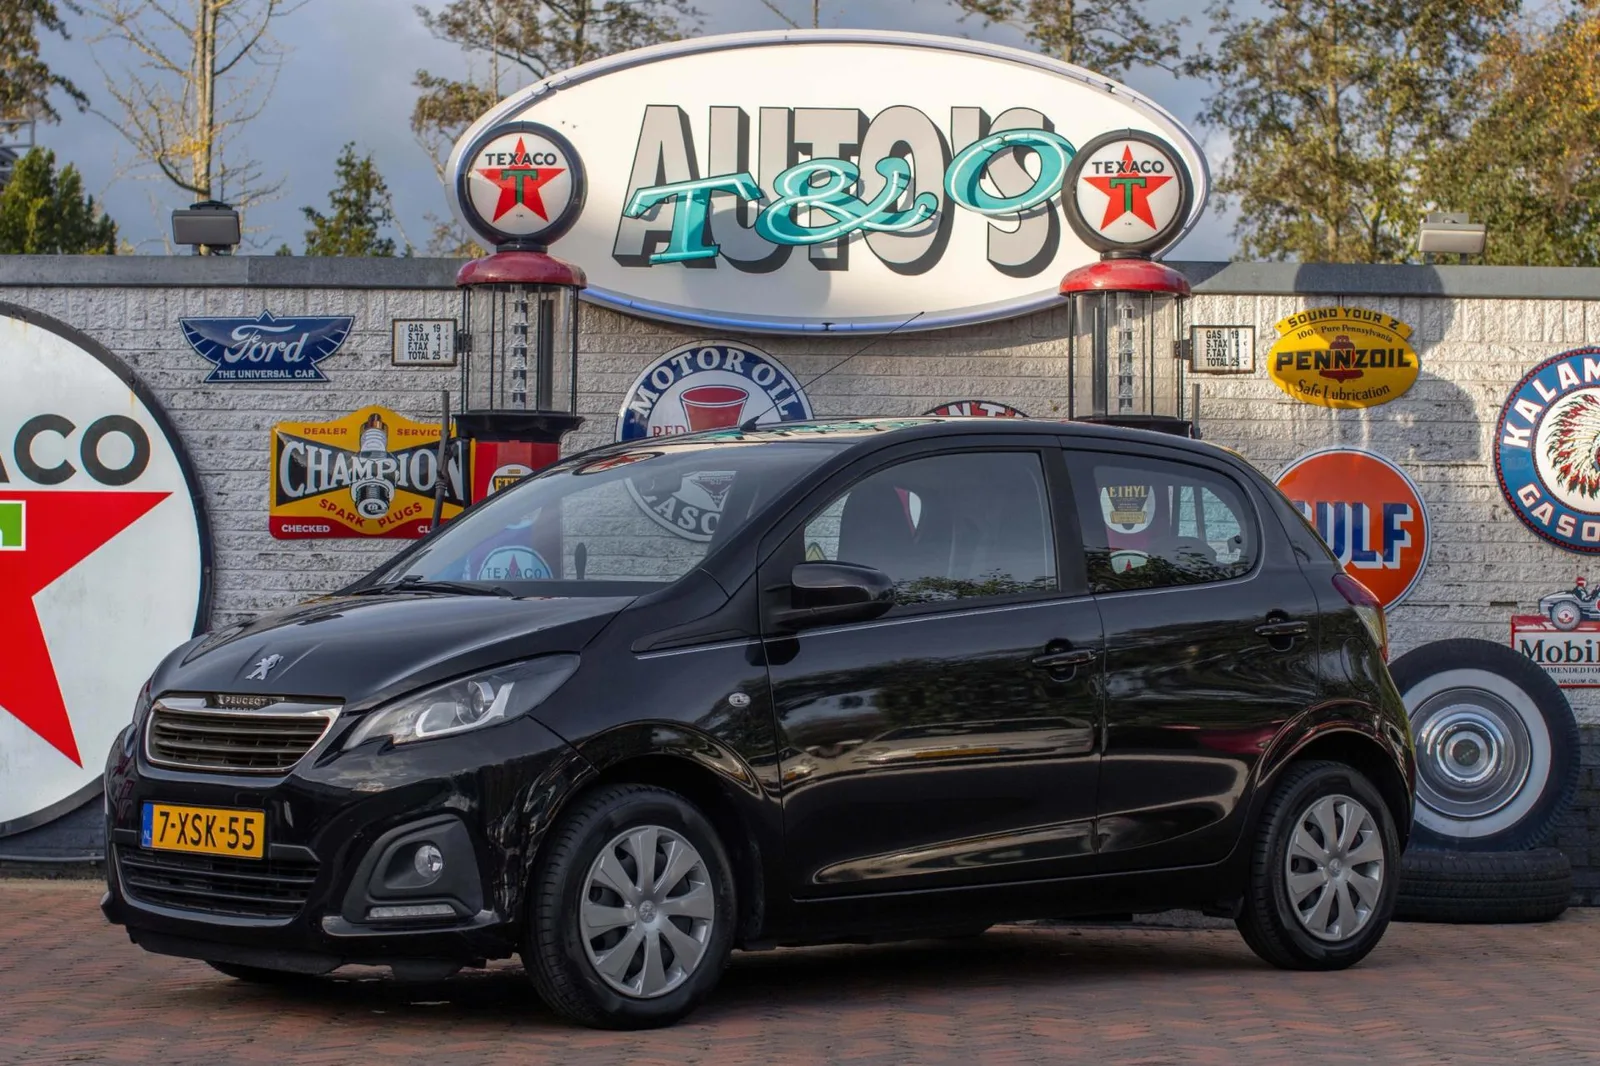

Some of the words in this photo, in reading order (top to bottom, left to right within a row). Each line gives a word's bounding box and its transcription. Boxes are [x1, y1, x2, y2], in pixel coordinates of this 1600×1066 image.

[485, 152, 557, 166] TEXACO
[1092, 160, 1164, 174] TEXACO
[1288, 308, 1338, 328] SOUND
[1343, 308, 1382, 324] YOUR
[1389, 319, 1400, 330] Z
[408, 323, 424, 333] GAS
[432, 323, 441, 333] 19
[1321, 325, 1341, 333] Pure
[1341, 324, 1393, 344] Pennsylvania
[408, 332, 430, 342] S.TAX
[1206, 330, 1222, 339] GAS
[1231, 330, 1239, 339] 19
[223, 324, 309, 364] Ford
[408, 342, 428, 351] F.TAX
[1206, 340, 1228, 349] S.TAX
[408, 351, 430, 360] TOTAL
[432, 351, 441, 360] 25
[1206, 349, 1227, 358] F.TAX
[1206, 358, 1229, 367] TOTAL
[1276, 348, 1412, 372] PENNZOIL
[217, 369, 236, 379] THE
[237, 369, 292, 379] UNIVERSAL
[295, 369, 316, 378] CAR
[629, 347, 746, 419] MOTOR
[751, 363, 799, 416] OIL
[1296, 379, 1322, 397] Safe
[1324, 384, 1391, 401] Lubrication
[303, 427, 348, 435] DEALER
[280, 440, 464, 500] CHAMPION
[319, 499, 365, 528] SPARK
[377, 502, 423, 528] PLUGS
[281, 524, 331, 533] CHECKED
[1291, 501, 1414, 570] ULF
[487, 567, 542, 579] TEXACO
[225, 696, 267, 706] PEUGEOT
[159, 810, 255, 851] 7-XSK-55
